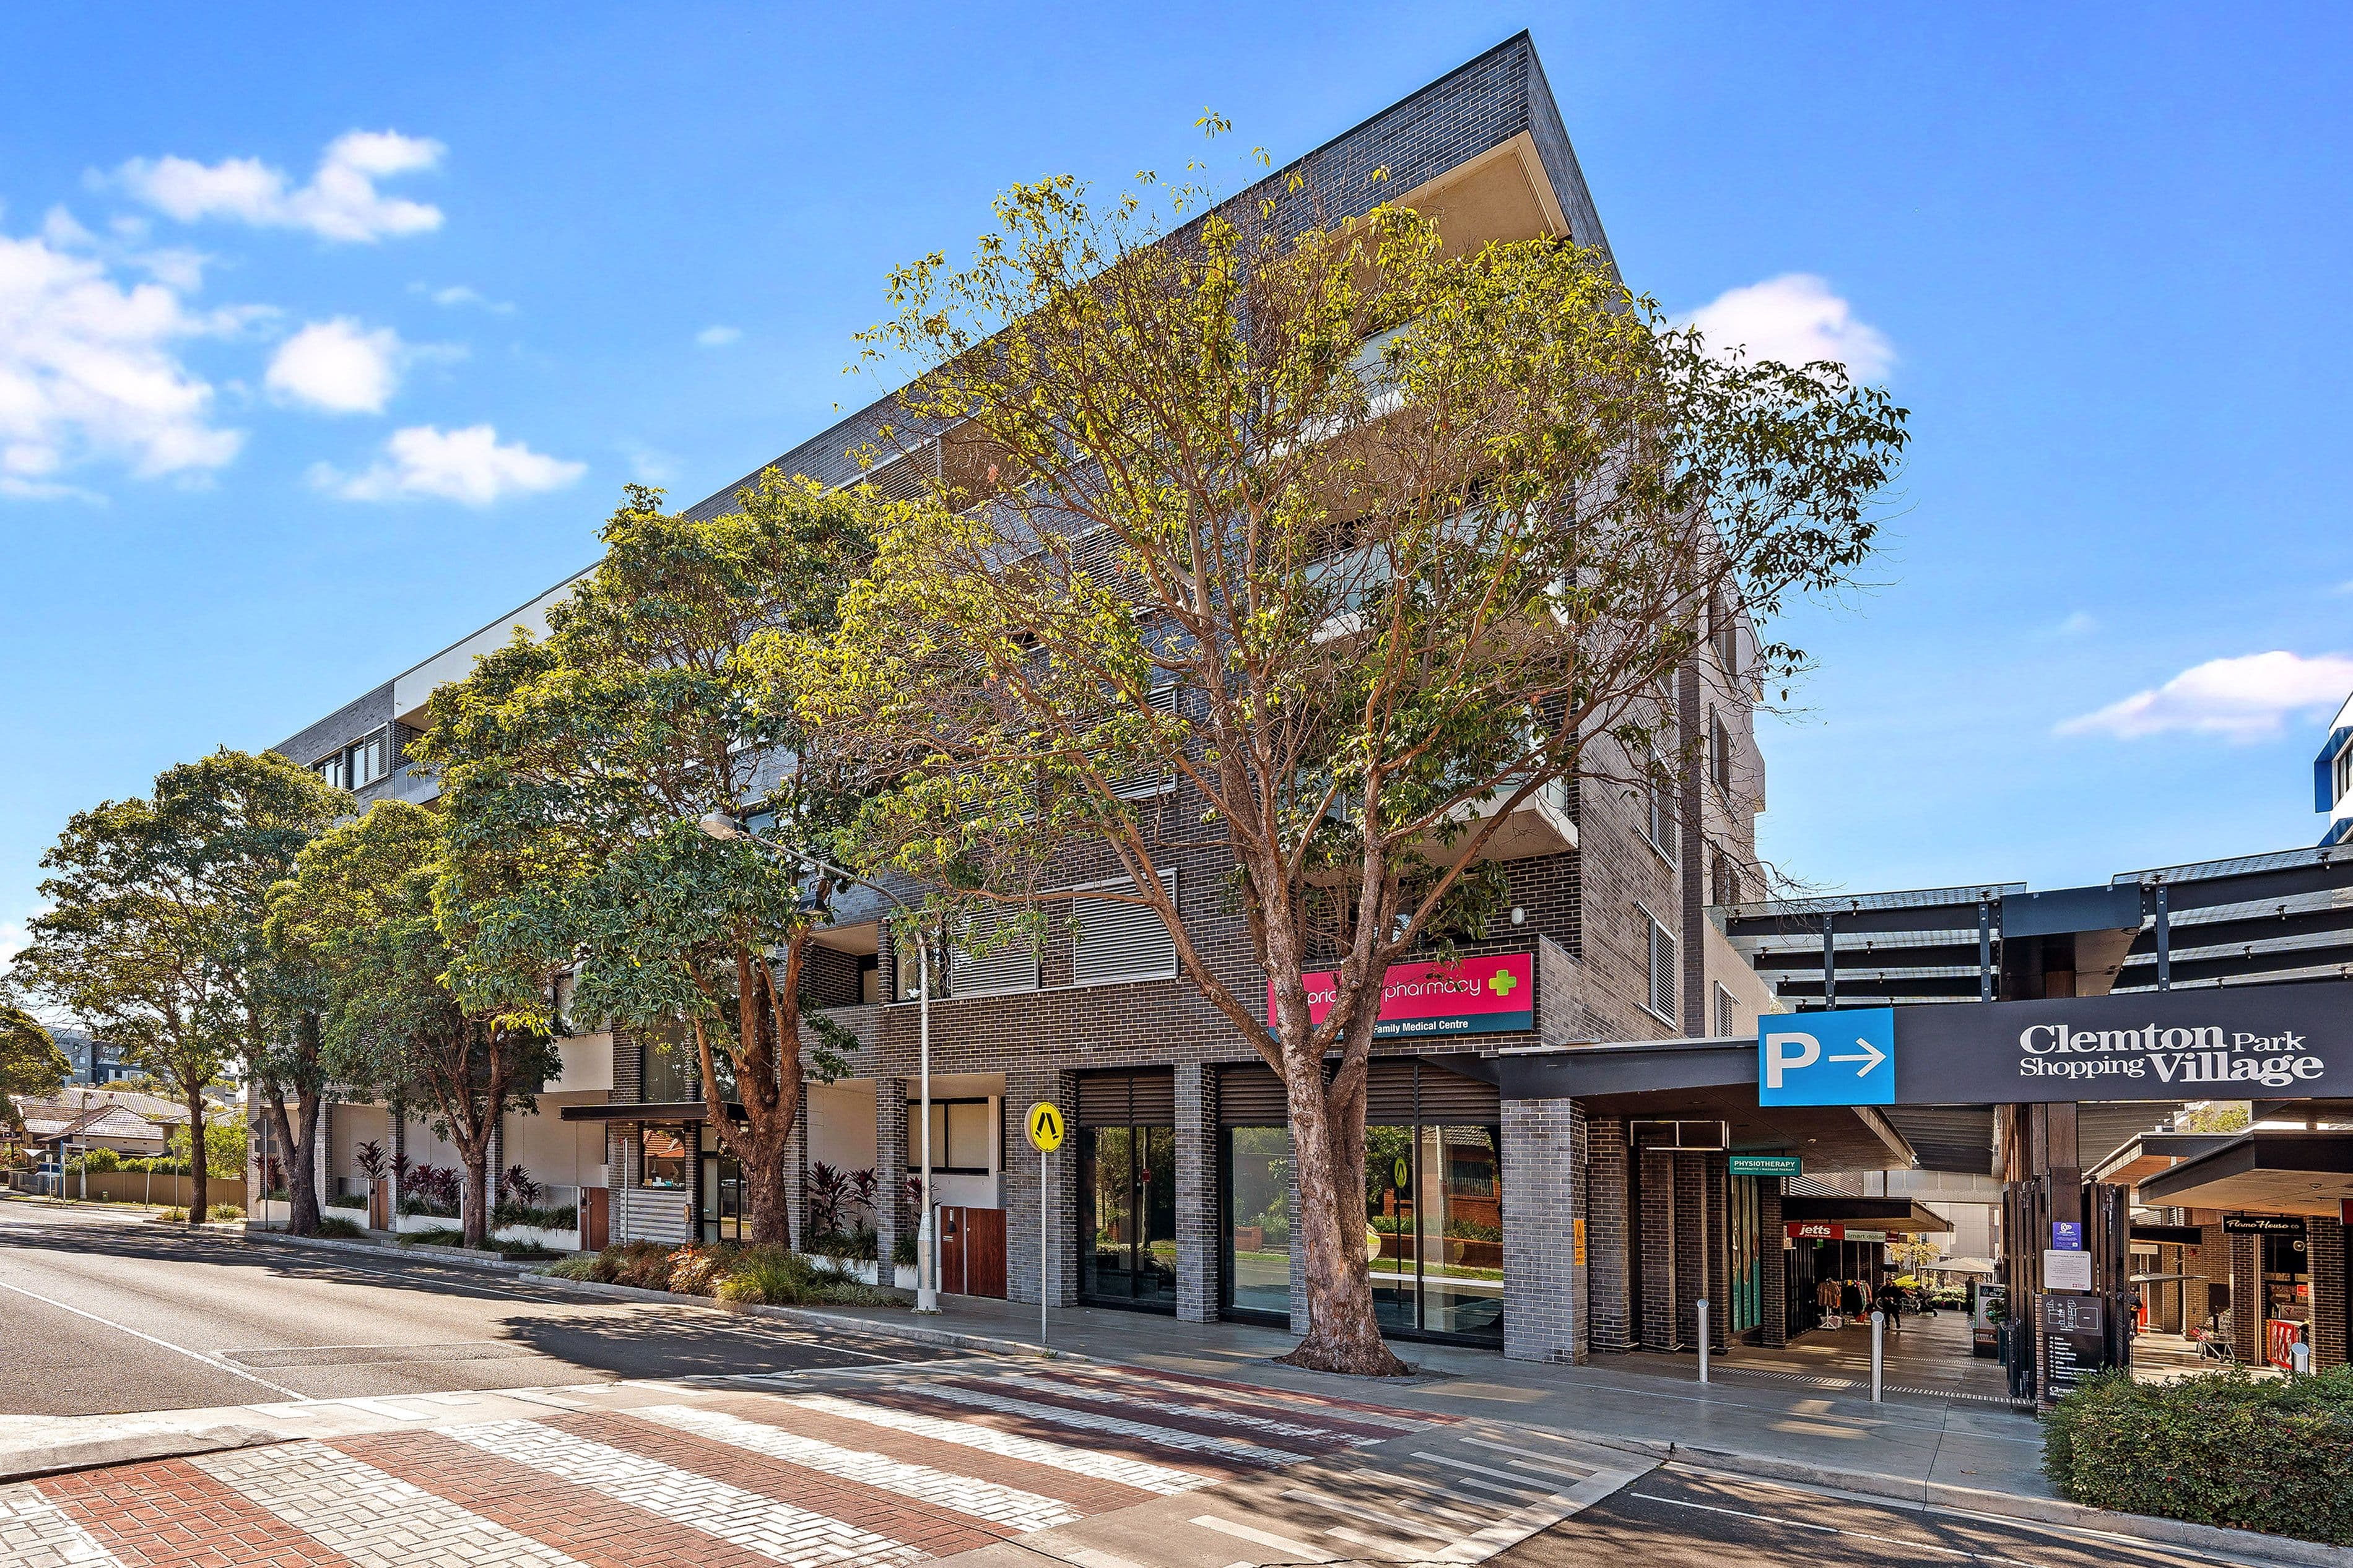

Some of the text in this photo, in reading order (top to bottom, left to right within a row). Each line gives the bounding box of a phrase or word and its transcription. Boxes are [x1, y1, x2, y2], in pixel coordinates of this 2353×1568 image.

[1385, 978, 1481, 1002] pharmacy
[1374, 1019, 1469, 1034] Family Medical Centre
[2020, 1023, 2307, 1054] Clemton Park
[1766, 1032, 1820, 1088] P
[2020, 1051, 2325, 1087] Shopping Village
[1799, 1224, 1831, 1236] jetts
